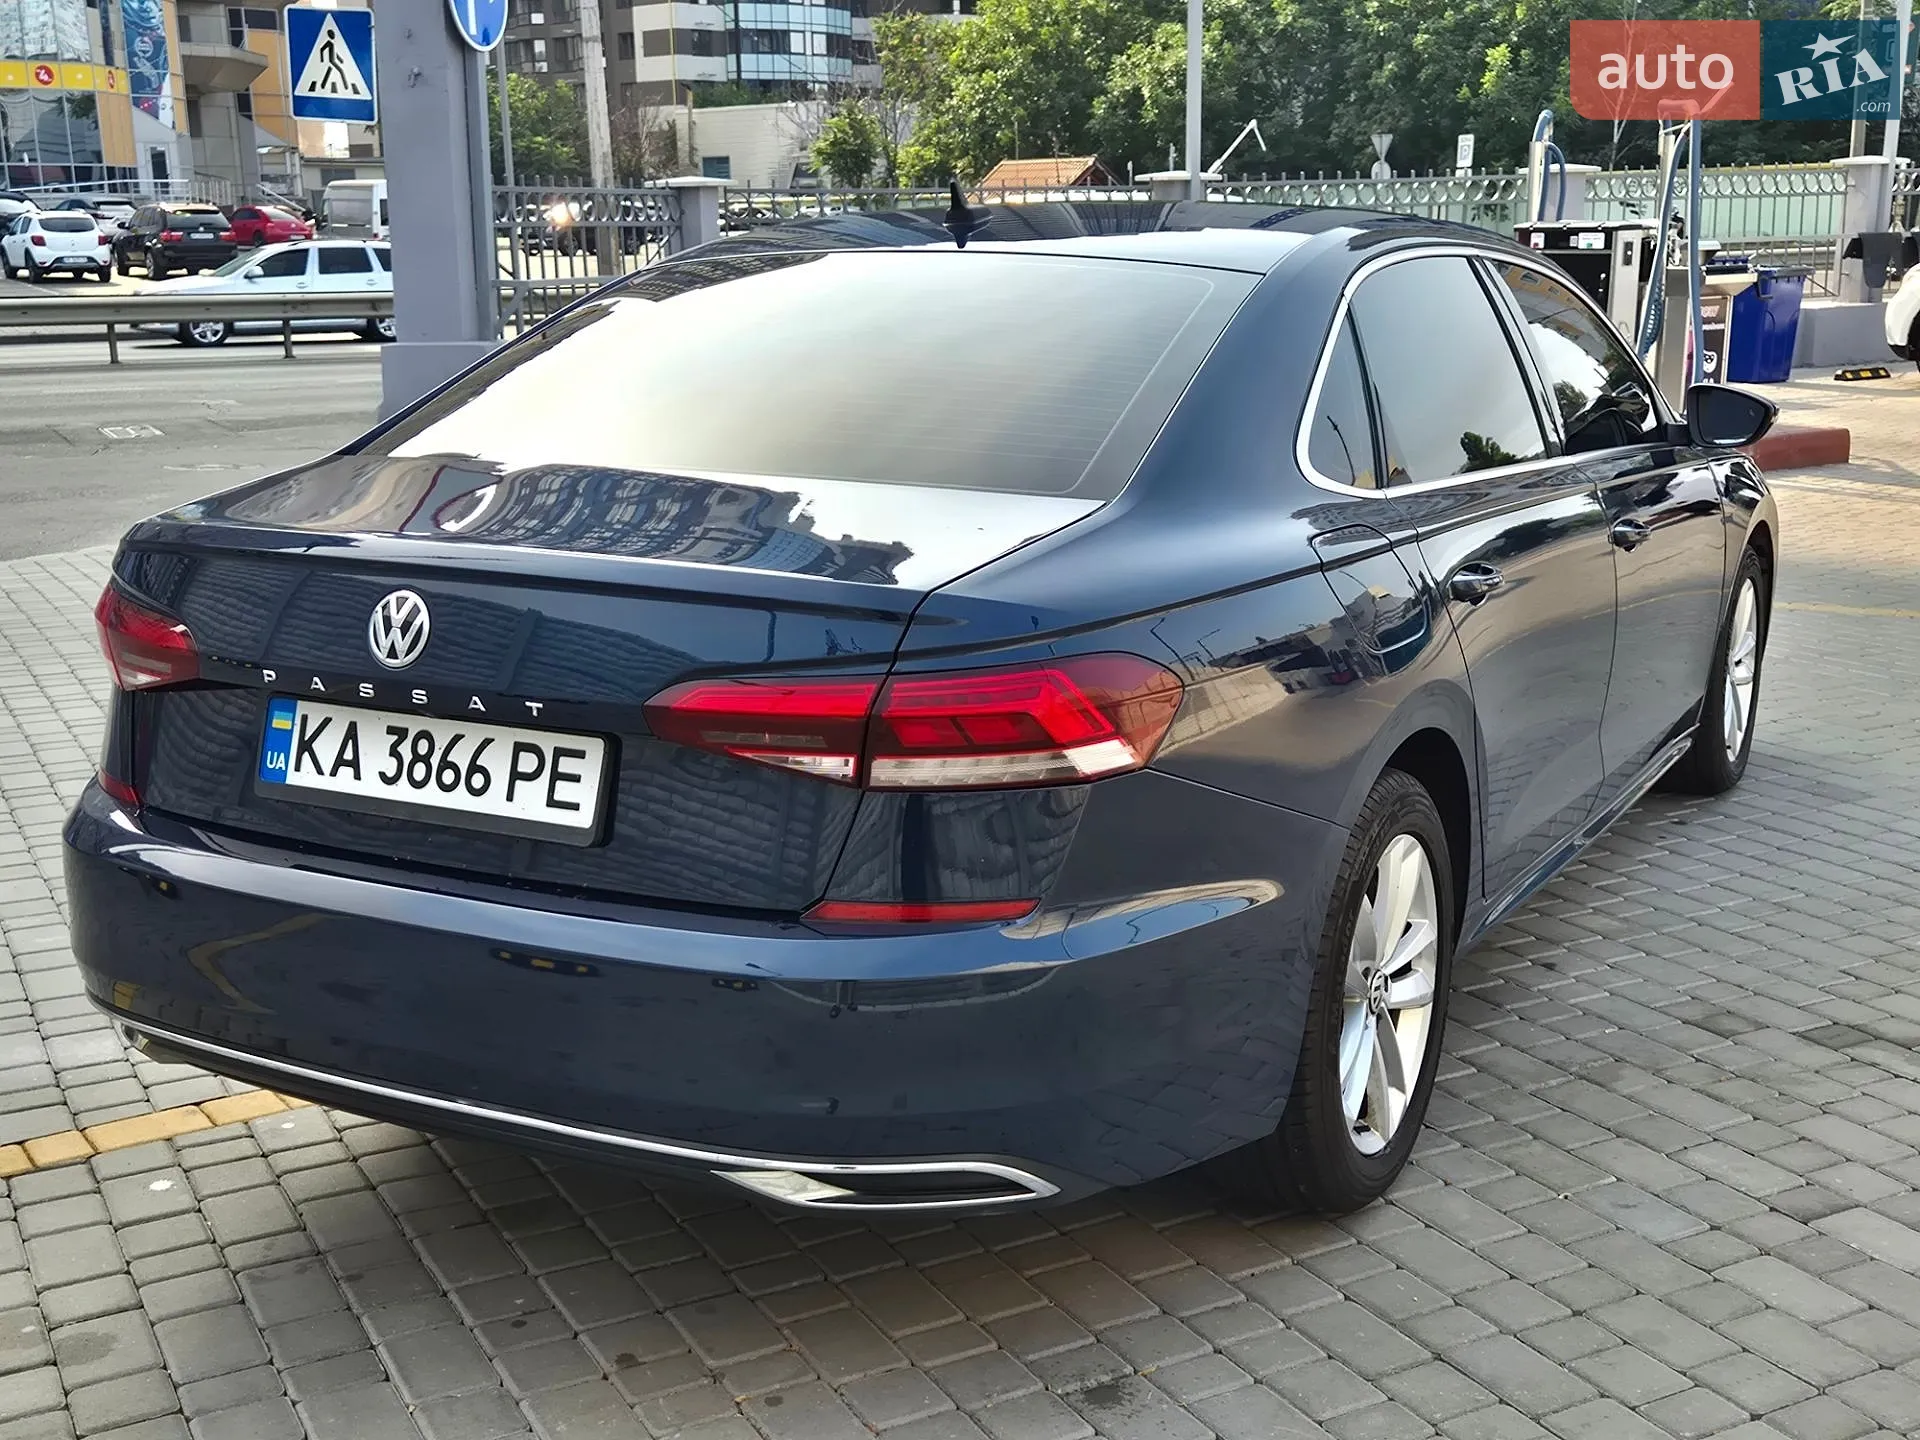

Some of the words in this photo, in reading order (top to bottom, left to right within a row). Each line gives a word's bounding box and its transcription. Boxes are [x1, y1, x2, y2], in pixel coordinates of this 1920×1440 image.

[262, 668, 544, 718] PASSAT
[266, 750, 286, 771] UA
[293, 713, 361, 781] KA
[377, 725, 495, 797] 3866
[506, 740, 587, 811] PE
